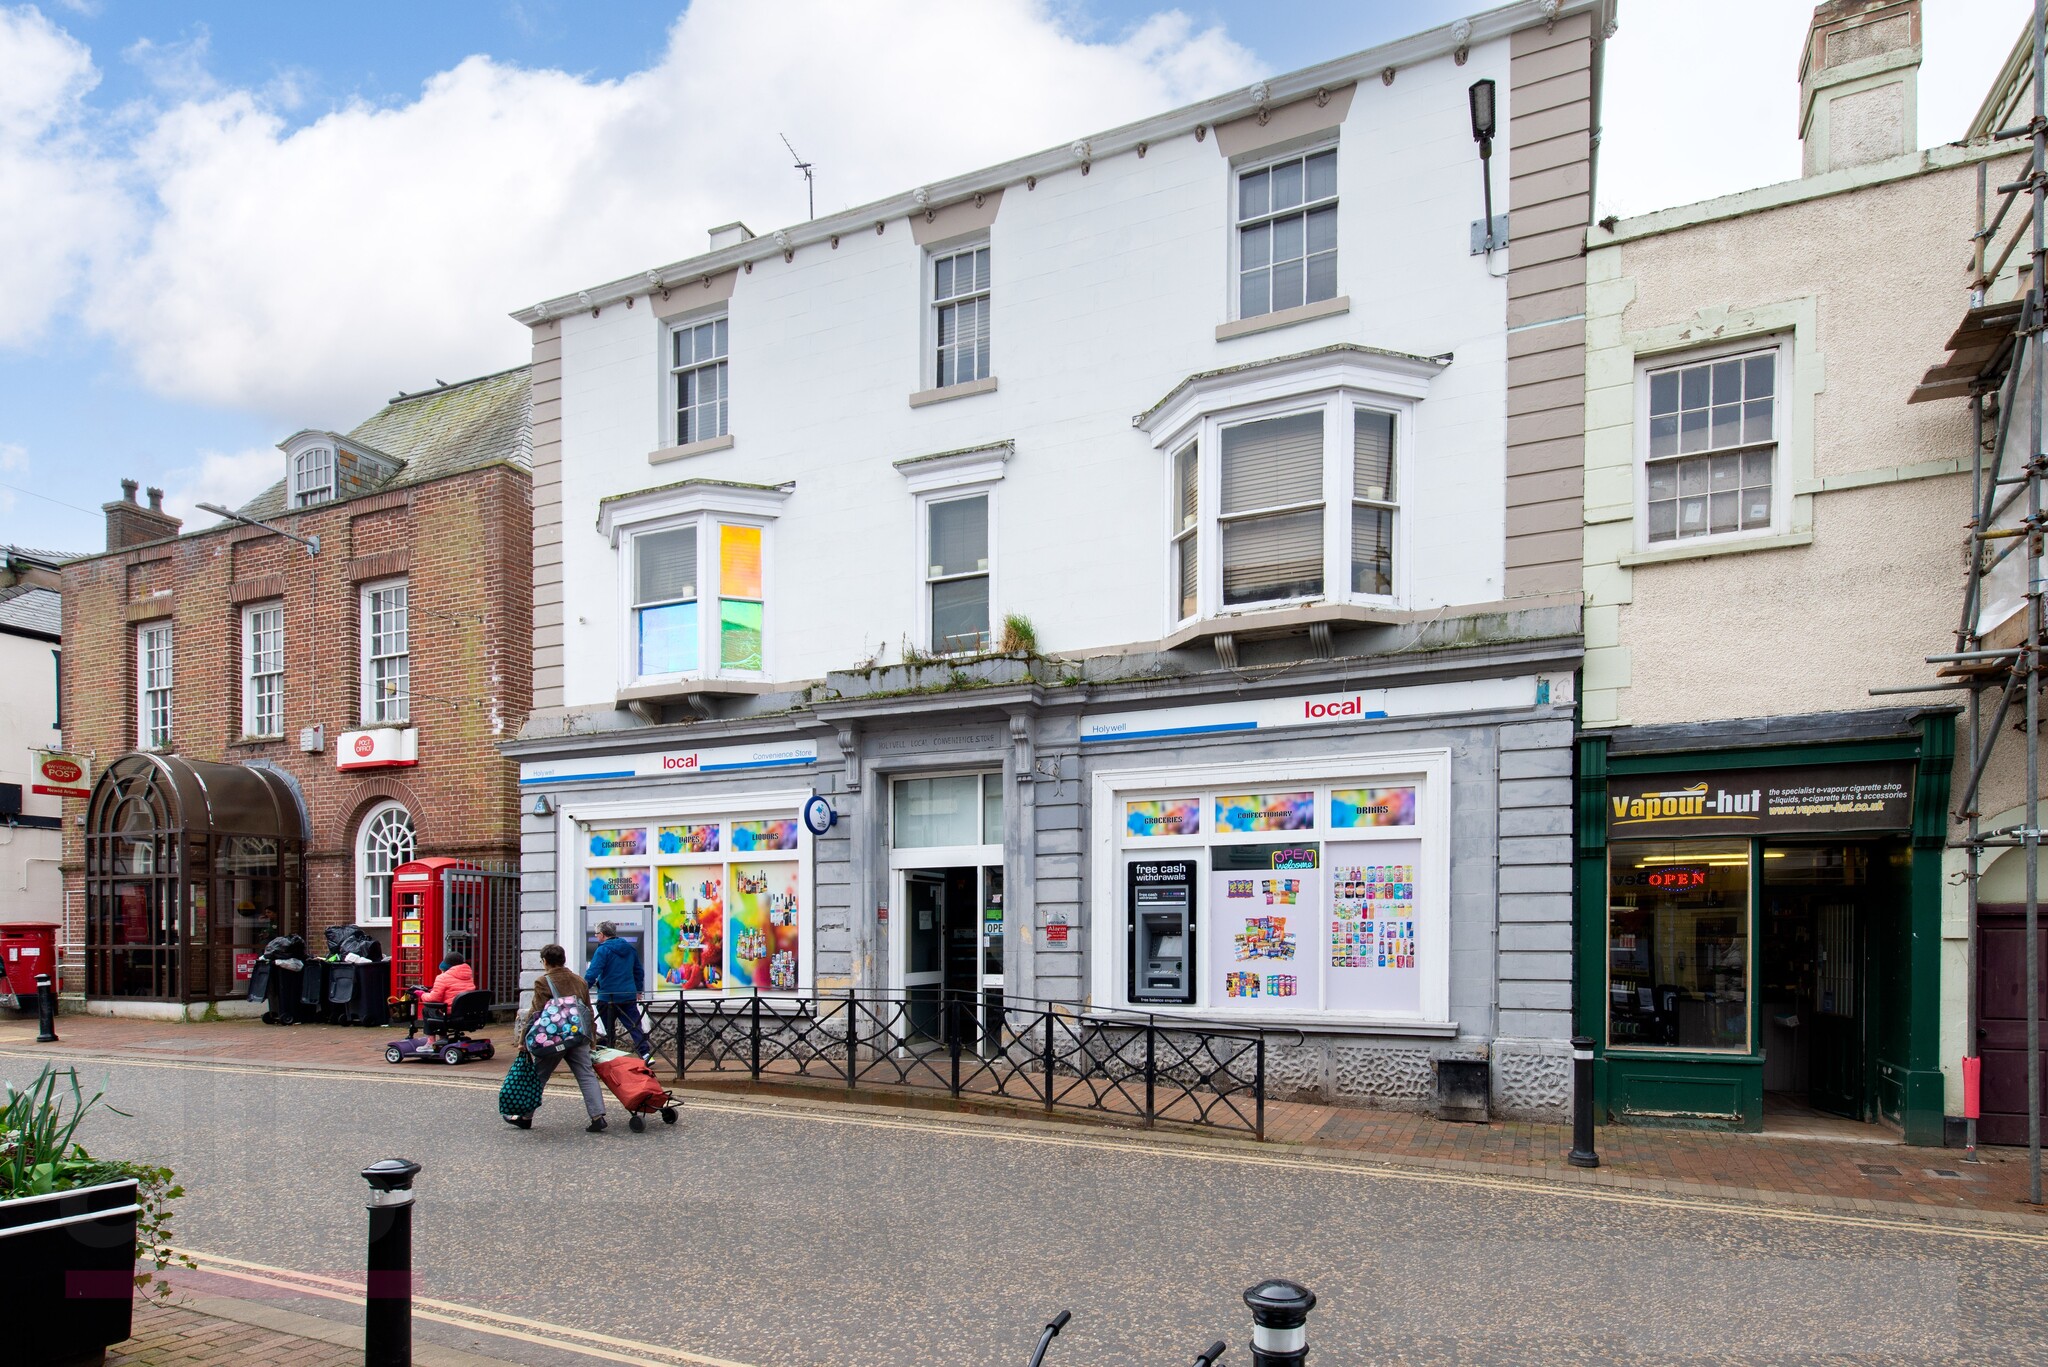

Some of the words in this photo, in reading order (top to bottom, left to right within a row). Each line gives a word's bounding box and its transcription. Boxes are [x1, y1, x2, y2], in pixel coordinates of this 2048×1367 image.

[1305, 696, 1362, 718] local
[1092, 722, 1128, 735] Holywell
[358, 738, 371, 746] POST
[356, 745, 372, 753] OFFICE
[752, 751, 794, 761] Convenience
[795, 749, 813, 757] Store
[663, 753, 698, 769] local
[48, 769, 77, 778] POST
[533, 769, 555, 778] Holywell
[1769, 788, 1780, 796] the
[1781, 786, 1816, 797] specialist
[1816, 785, 1849, 795] e-vapour
[1850, 784, 1881, 793] cigarette
[1883, 782, 1902, 791] shop
[1769, 795, 1801, 805] e-liquids,
[1802, 794, 1840, 804] e-cigarette
[1841, 792, 1854, 801] kits
[1856, 792, 1862, 800] &
[1863, 791, 1908, 800] accessories
[1612, 789, 1762, 820] Vapour-hut
[1769, 799, 1886, 816] www.vapour-hut.co.uk
[1237, 810, 1293, 819] CONFECTIONARY
[1356, 805, 1389, 815] DRINKS
[1144, 816, 1183, 825] GROCERIES
[678, 835, 700, 844] VAPES
[752, 832, 779, 841] LIQUORS
[601, 840, 637, 849] CIGARETTES
[1274, 847, 1314, 863] OPEN
[1135, 864, 1158, 874] free
[1160, 863, 1187, 874] cash
[1276, 859, 1314, 870] welcome
[1135, 873, 1187, 882] withdrawals
[1648, 872, 1705, 886] OPEN
[987, 923, 1004, 933] OPE
